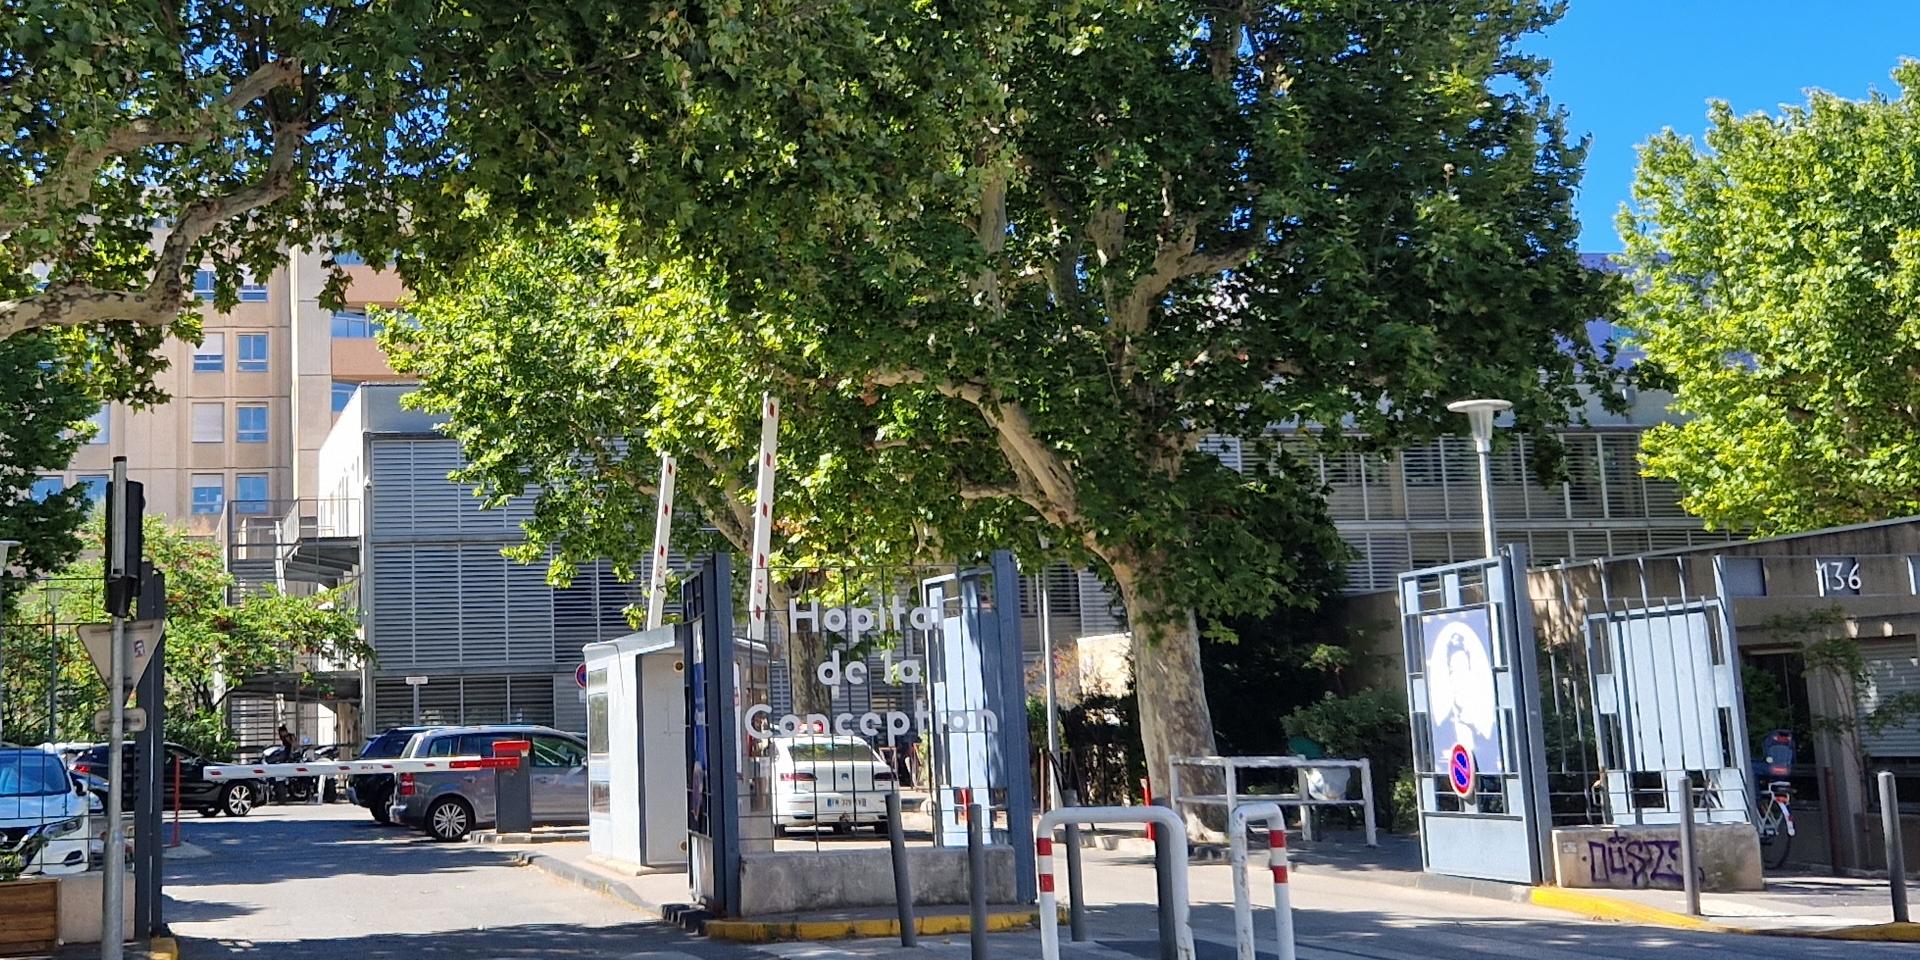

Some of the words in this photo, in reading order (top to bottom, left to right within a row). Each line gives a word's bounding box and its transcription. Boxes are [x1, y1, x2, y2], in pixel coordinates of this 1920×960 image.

[1819, 562, 1861, 591] 136
[817, 650, 867, 686] de
[885, 650, 920, 685] la
[744, 699, 998, 748] Conception
